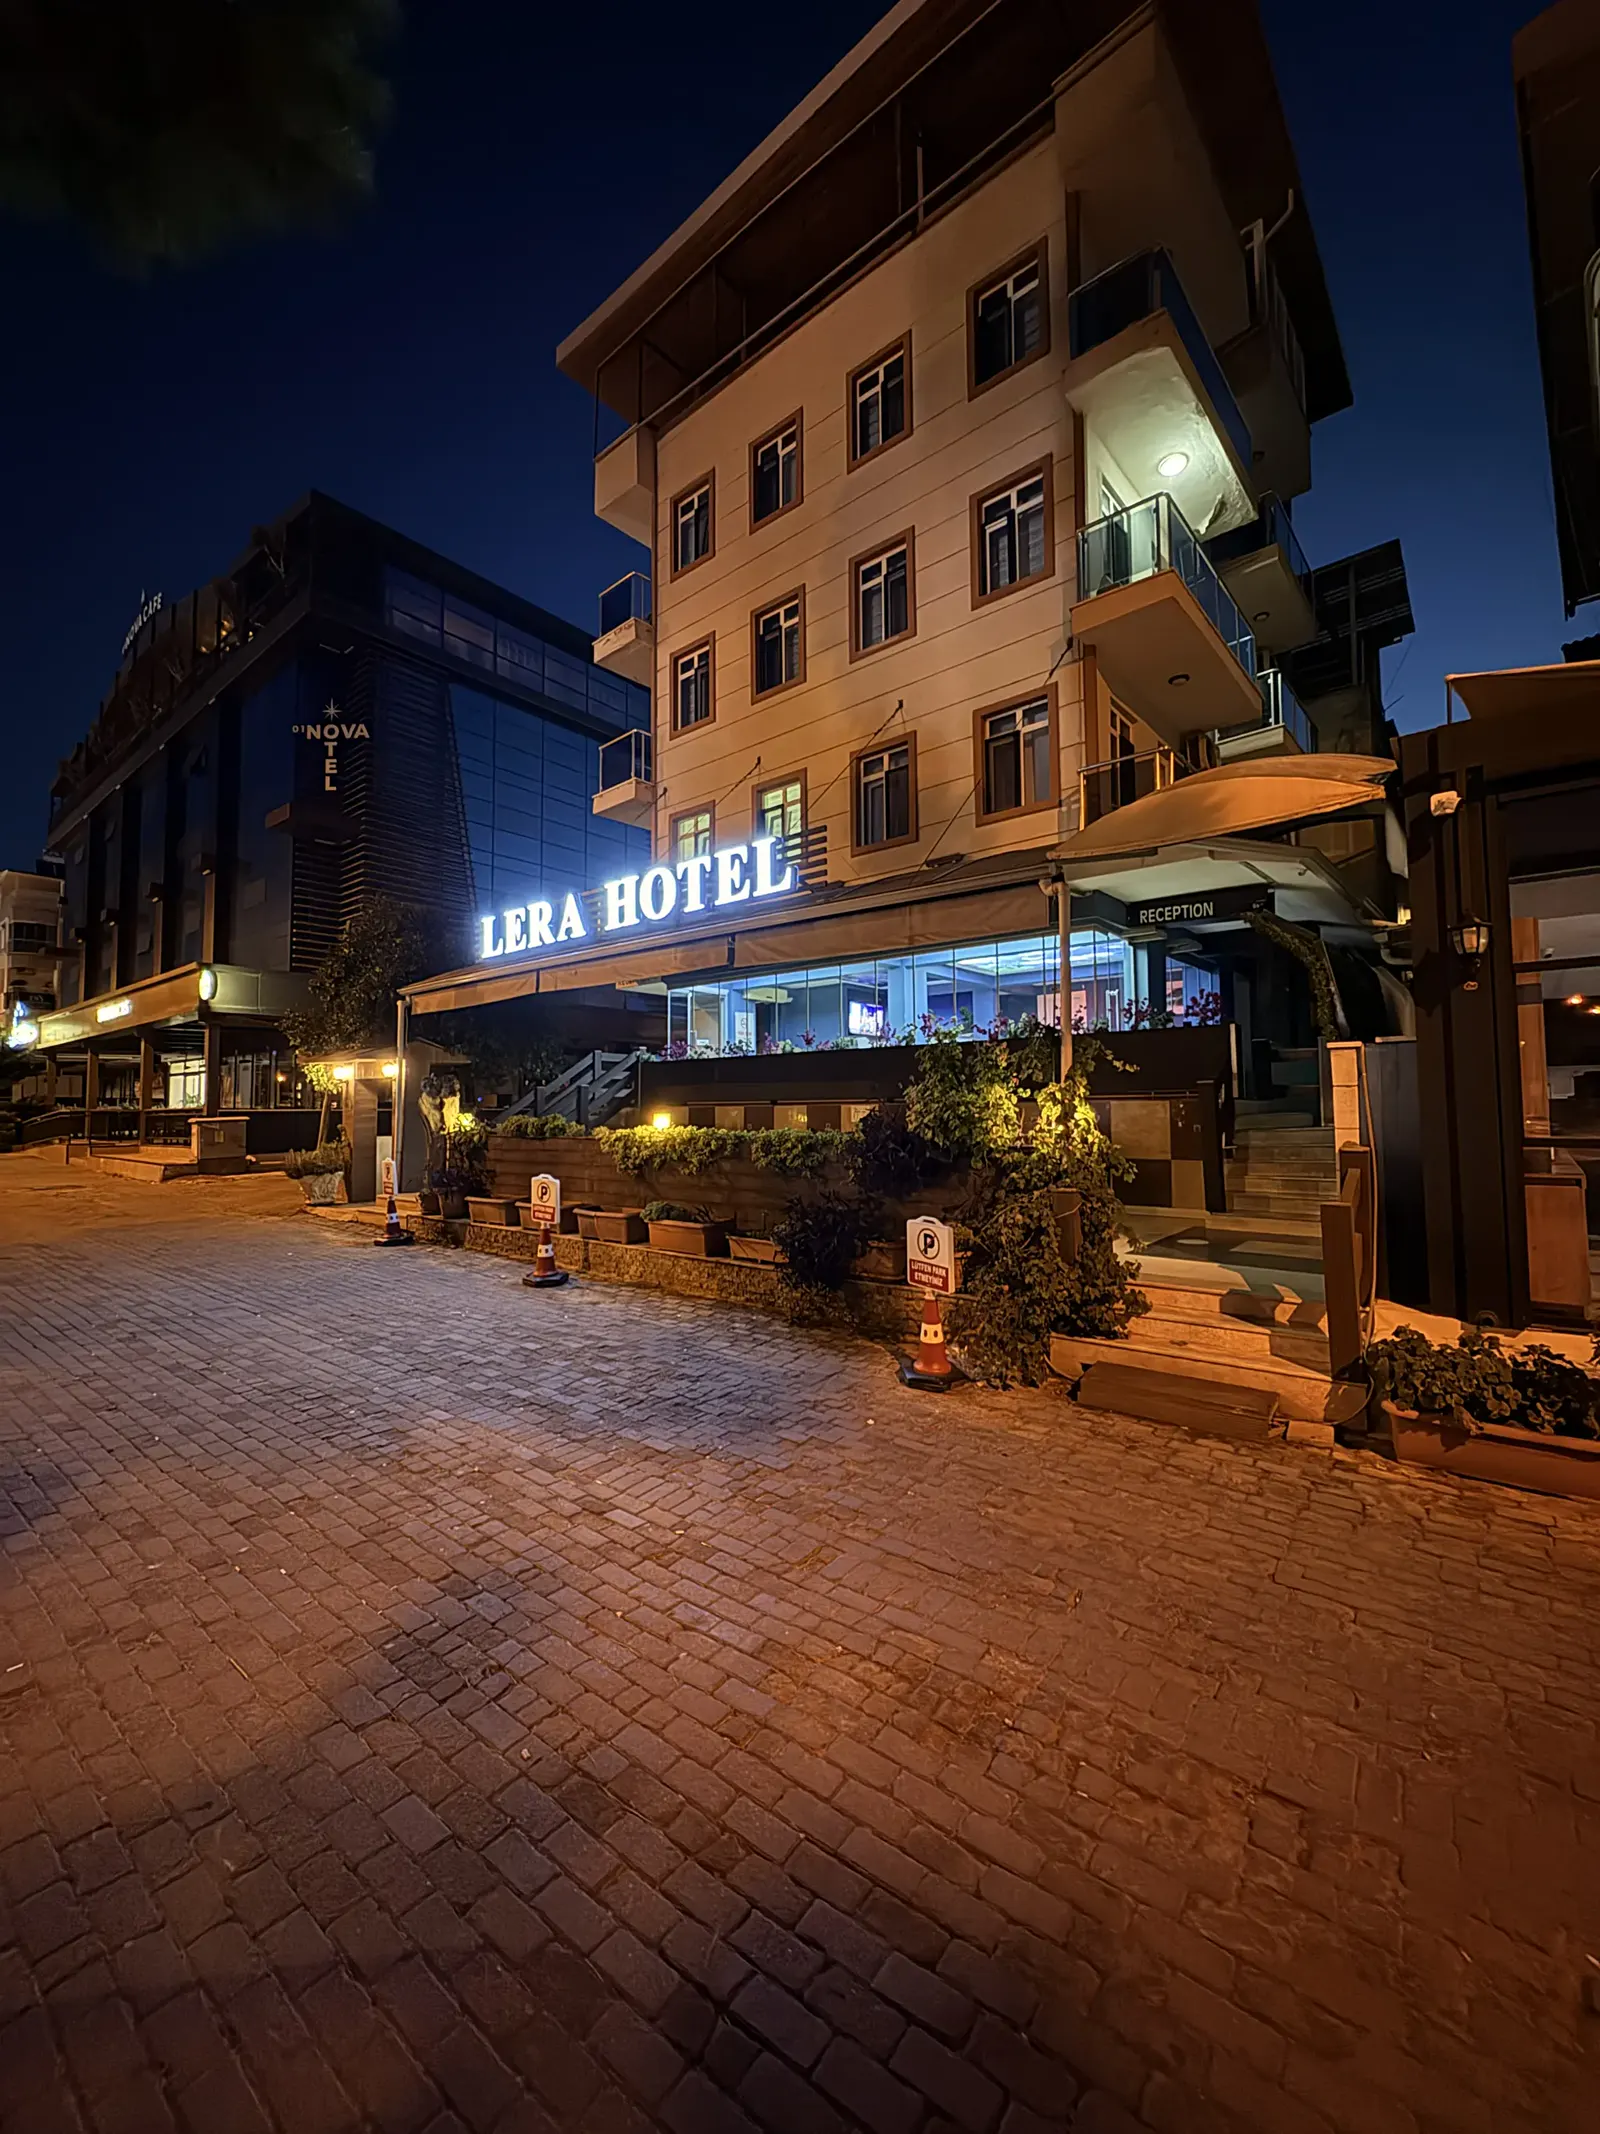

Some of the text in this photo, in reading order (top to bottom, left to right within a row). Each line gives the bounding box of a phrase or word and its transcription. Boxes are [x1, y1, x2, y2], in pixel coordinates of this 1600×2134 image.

[143, 592, 162, 622] CAFE
[481, 836, 794, 959] LERA HOTEL
[1139, 901, 1214, 924] RECEPTION
[932, 1266, 946, 1277] PARK
